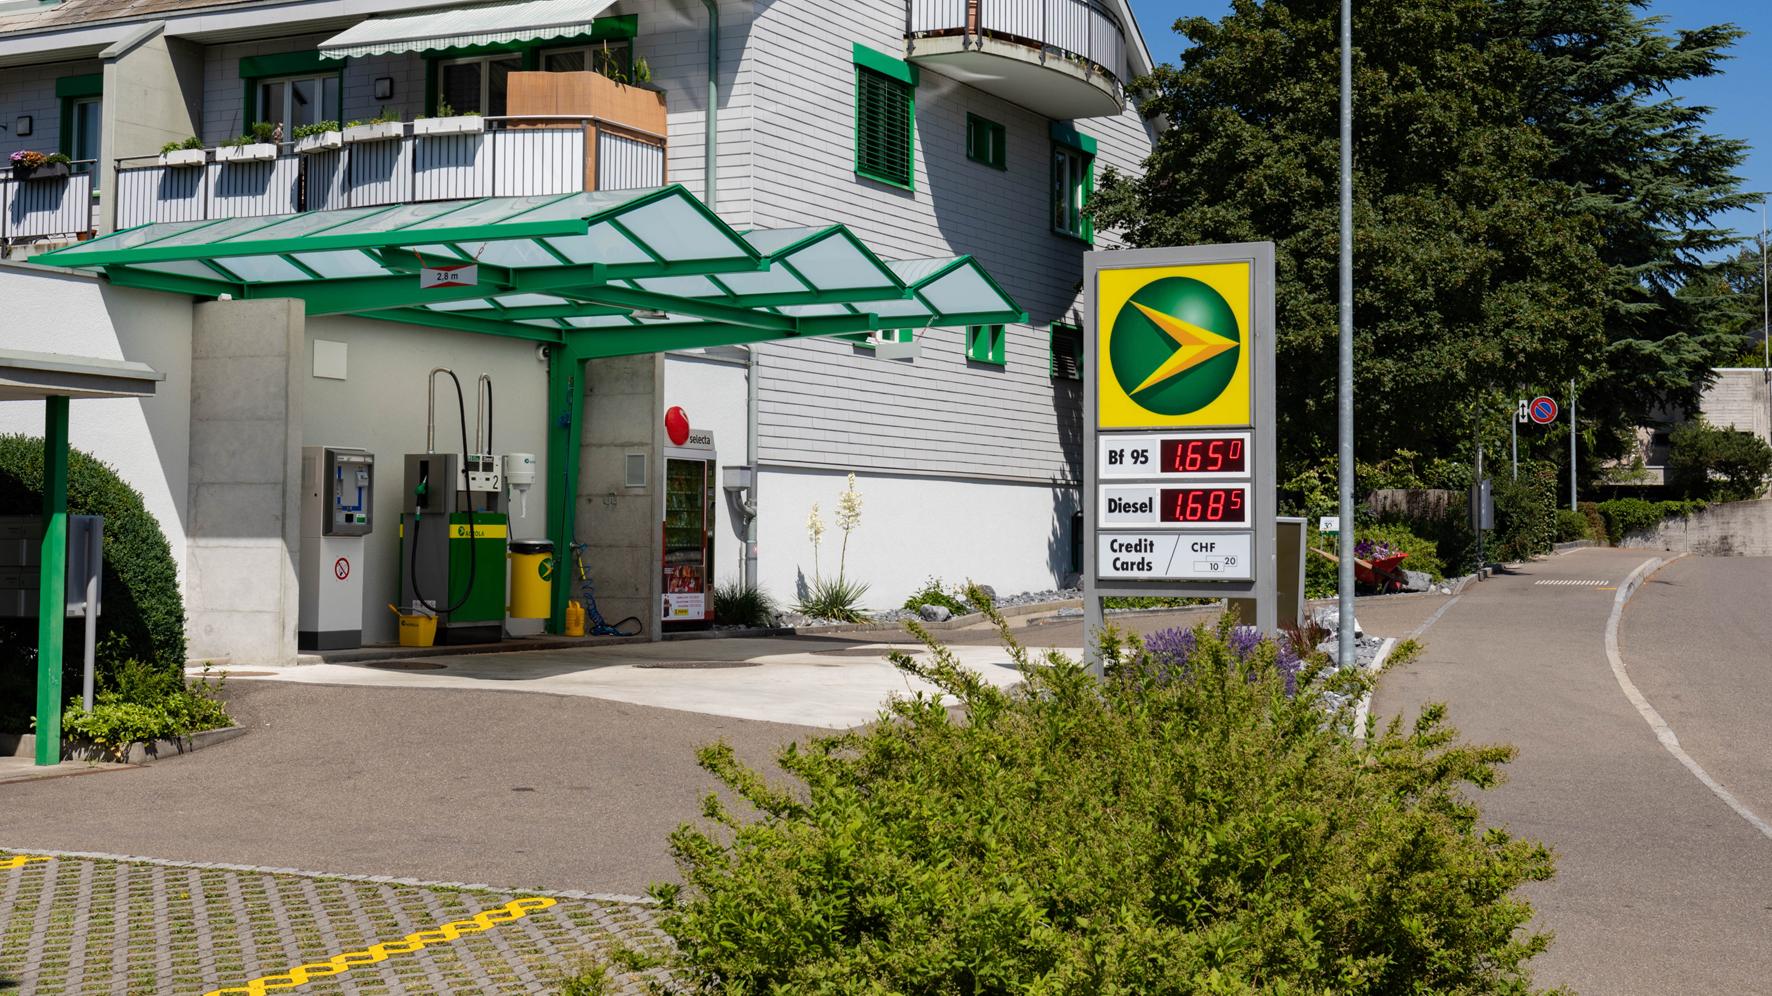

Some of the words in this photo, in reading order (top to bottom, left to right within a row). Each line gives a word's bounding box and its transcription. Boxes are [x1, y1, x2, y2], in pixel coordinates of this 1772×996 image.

[437, 272, 448, 281] 2,8
[690, 435, 711, 445] selecta
[1108, 448, 1125, 465] Bf
[1130, 448, 1149, 465] 95
[493, 475, 499, 489] 2
[1107, 496, 1153, 513] Diesel
[1110, 538, 1154, 553] Credit
[1191, 542, 1216, 552] CHF
[1112, 557, 1153, 571] Cards
[1209, 562, 1219, 571] 10
[1224, 557, 1236, 565] 20
